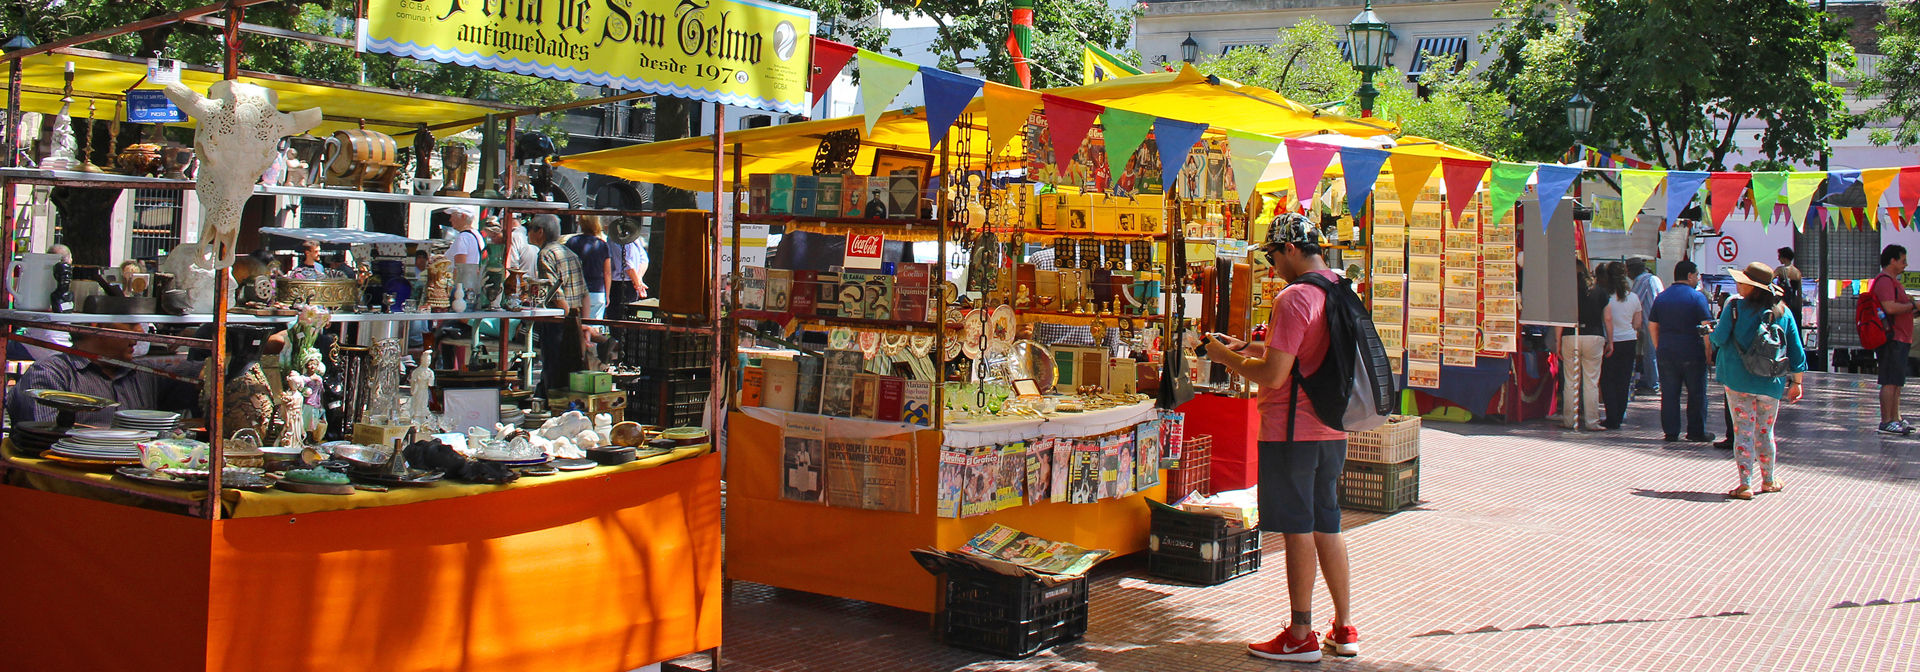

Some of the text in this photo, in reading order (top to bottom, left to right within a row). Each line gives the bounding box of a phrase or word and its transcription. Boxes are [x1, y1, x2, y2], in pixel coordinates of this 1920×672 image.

[396, 12, 426, 22] comuna
[557, 0, 592, 35] de
[594, 0, 666, 48] San
[674, 0, 763, 65] Telmo
[457, 21, 589, 61] antiguedades
[639, 53, 749, 84] desde 197
[774, 82, 788, 90] GCBA
[903, 270, 923, 278] Coelho
[896, 288, 928, 297] Alquimista
[941, 452, 965, 464] El Gráfico
[973, 455, 997, 464] Gráfico
